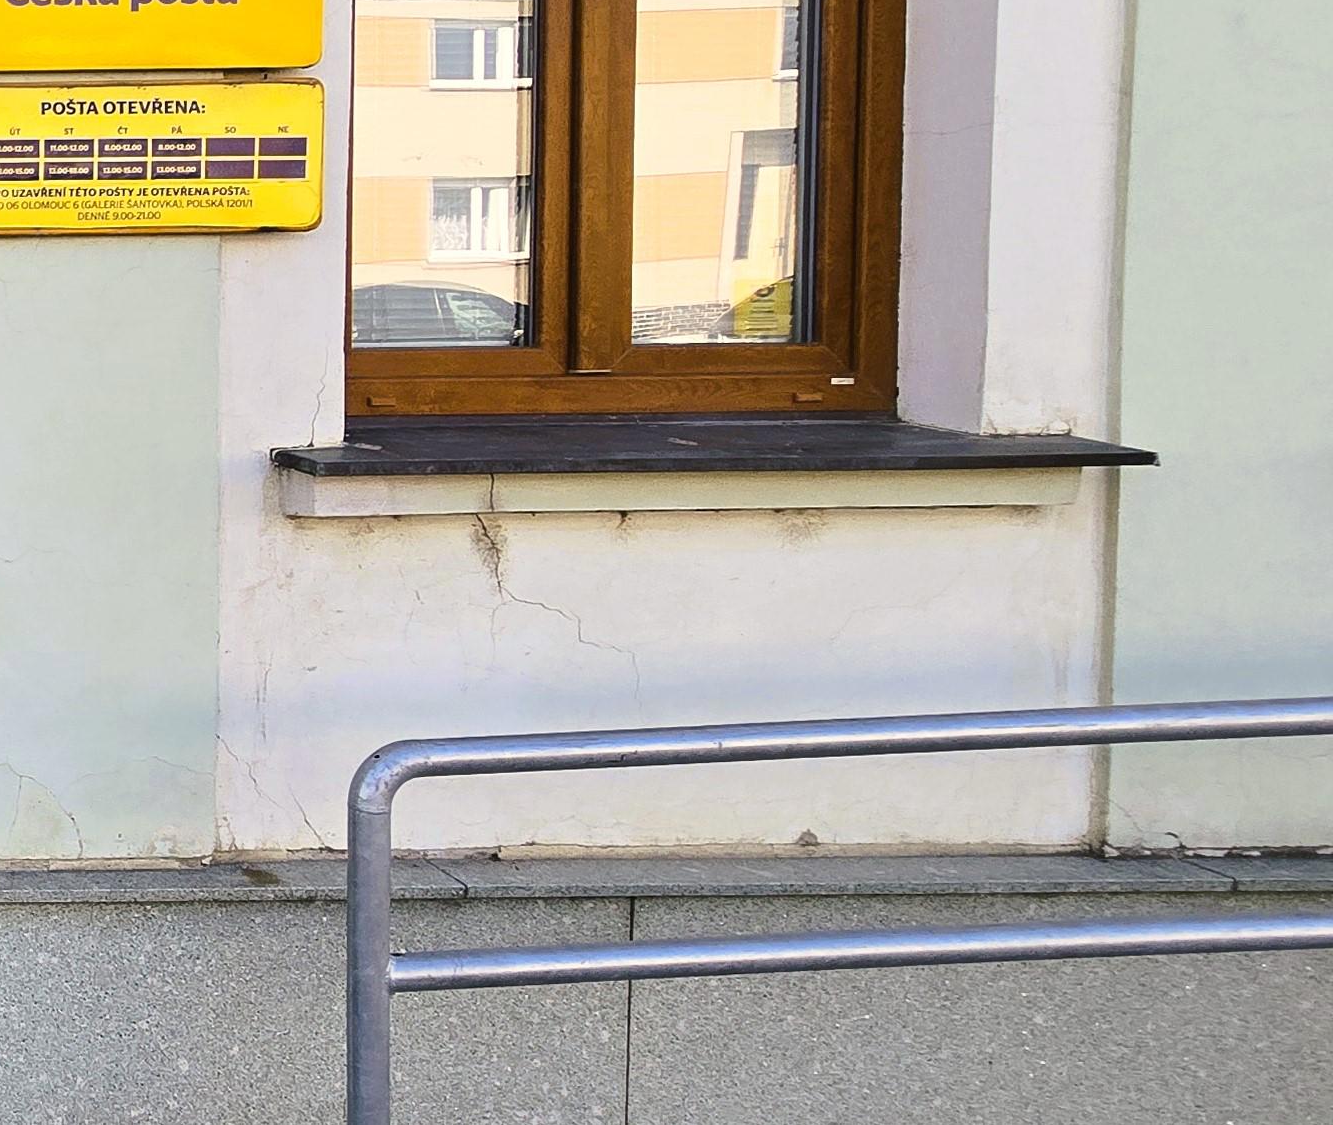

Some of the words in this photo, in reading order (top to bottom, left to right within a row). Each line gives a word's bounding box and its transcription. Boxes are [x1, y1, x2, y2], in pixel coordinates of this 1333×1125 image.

[41, 99, 98, 115] POŠTA
[103, 98, 206, 114] OTEVŘENA:
[9, 127, 21, 136] ÚT
[118, 126, 128, 135] ČT
[171, 126, 183, 134] PÁ
[225, 126, 237, 134] SO
[12, 187, 66, 198] UZAVŘENÍ
[69, 187, 97, 197] TÉTO
[99, 187, 134, 197] POŠTY
[136, 188, 149, 196] JE
[151, 187, 210, 196] OTEVŘENA
[212, 186, 250, 196] POŠTA:
[7, 201, 20, 210] 06
[21, 201, 71, 210] OLOMOUC
[73, 200, 79, 209] 6
[81, 200, 124, 210] (GALERIE
[186, 198, 224, 208] POLSKÁ
[226, 199, 253, 208] 1201/1
[112, 211, 161, 220] 9.00-21.00
